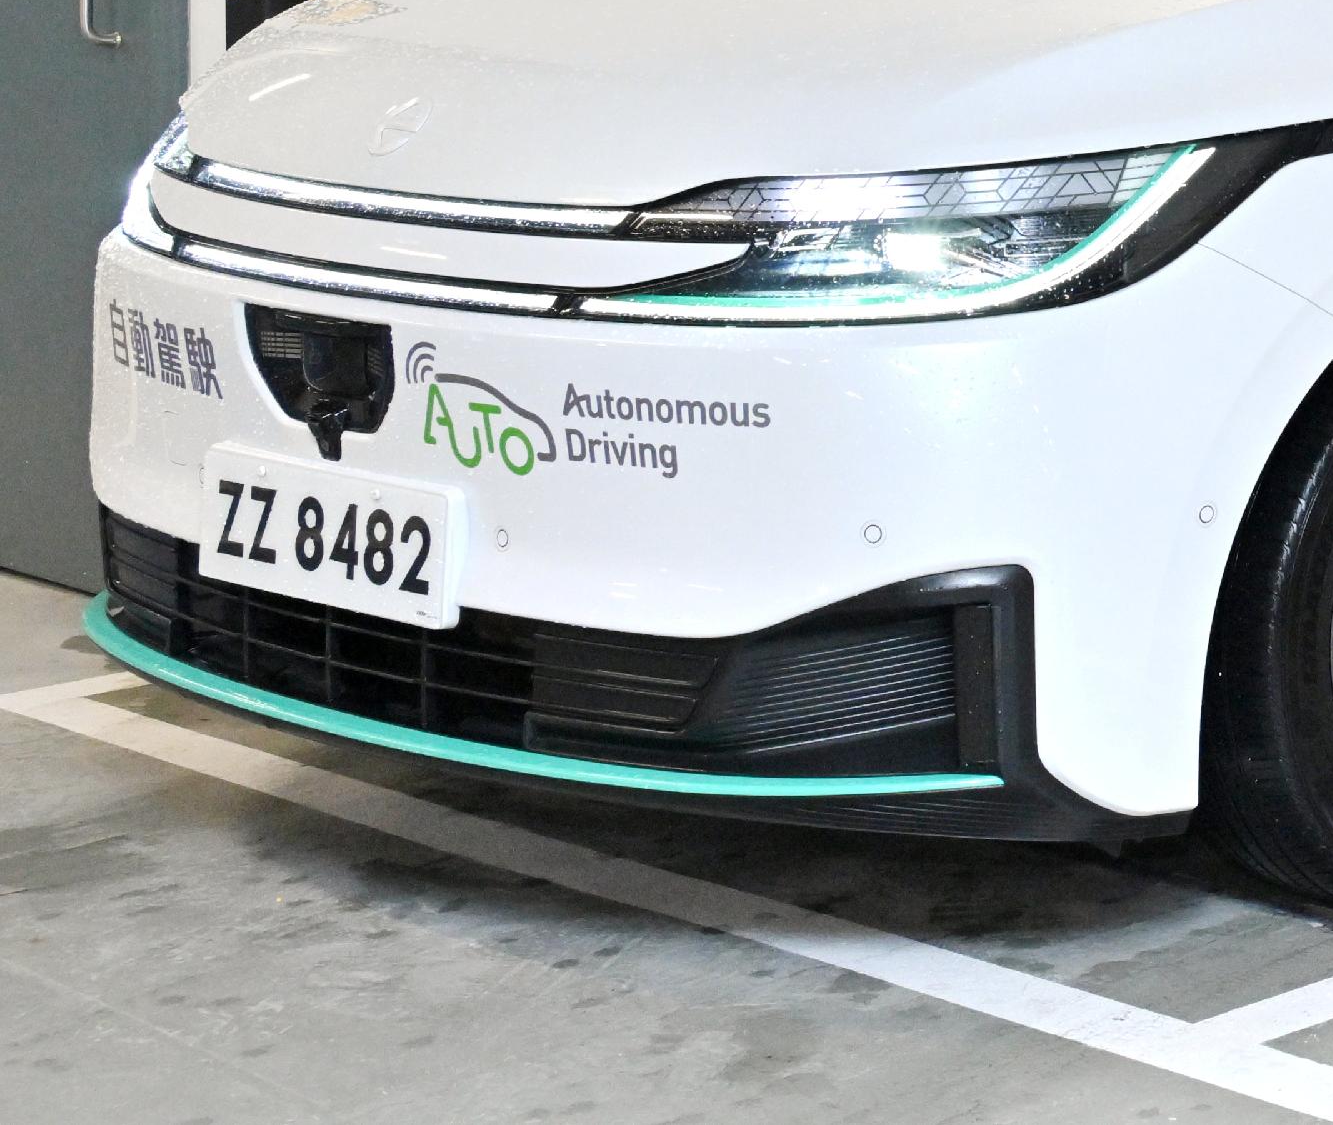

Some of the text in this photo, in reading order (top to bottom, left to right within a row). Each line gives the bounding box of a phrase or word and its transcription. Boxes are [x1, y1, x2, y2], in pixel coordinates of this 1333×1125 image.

[109, 298, 224, 400] 自動駕駛
[562, 382, 772, 428] Autonomous
[565, 427, 679, 478] Driving
[216, 479, 432, 596] ZZ 8482
